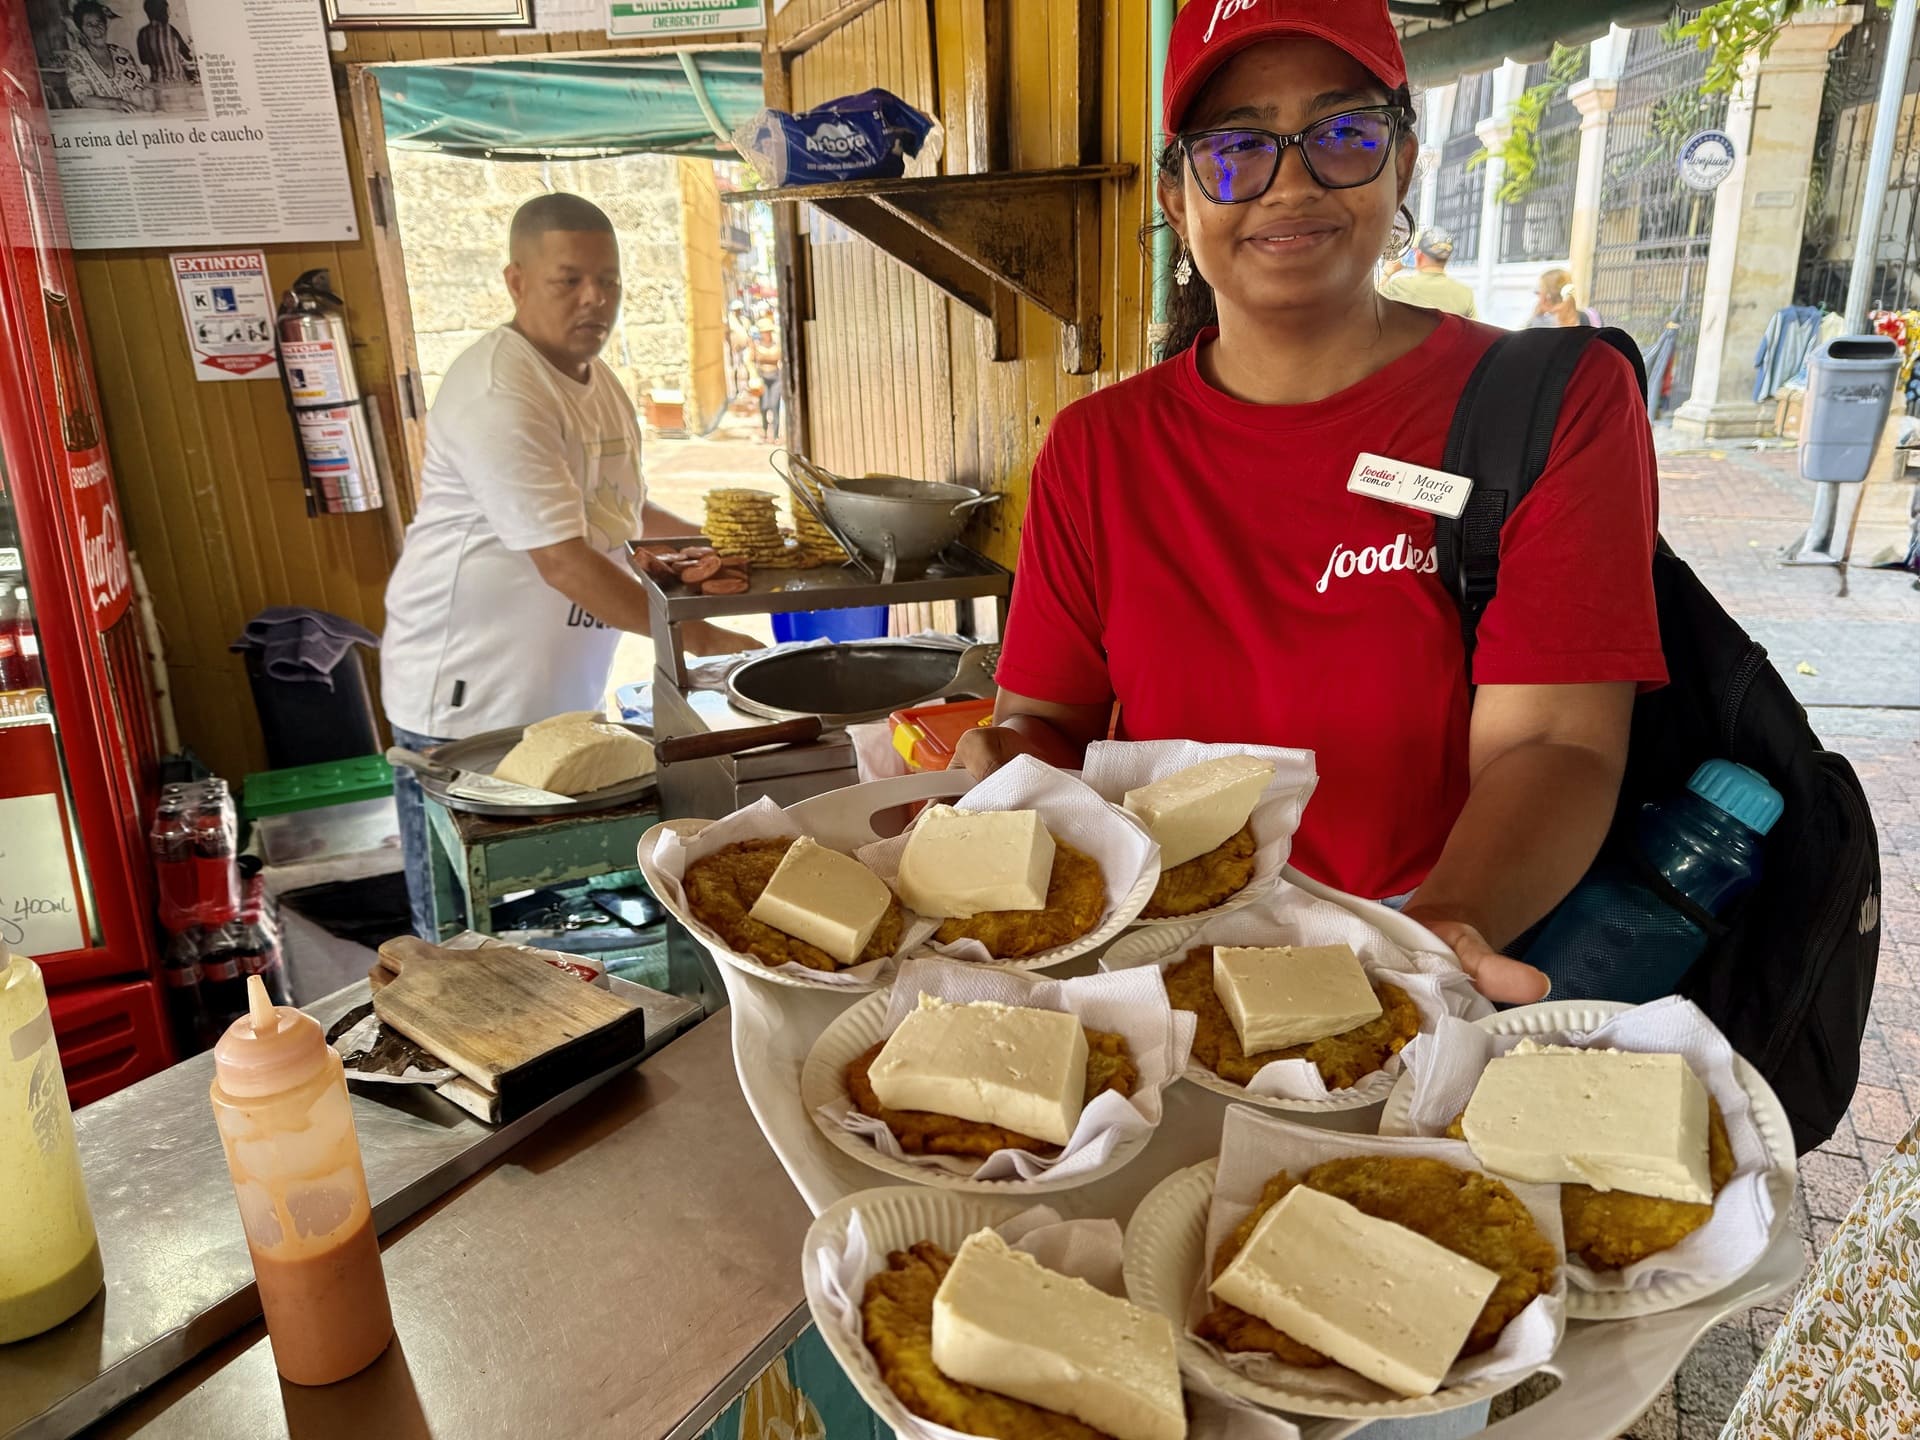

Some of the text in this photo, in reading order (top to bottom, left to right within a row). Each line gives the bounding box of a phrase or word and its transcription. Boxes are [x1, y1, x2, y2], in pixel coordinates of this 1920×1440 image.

[652, 13, 720, 29] EMERGENCY EXIT
[51, 133, 70, 149] La
[75, 131, 112, 148] reina
[116, 129, 138, 146] del
[142, 128, 185, 149] palito
[189, 127, 206, 143] de
[210, 125, 264, 142] caucho
[806, 133, 867, 152] Arbora
[175, 255, 261, 271] EXTINTOR
[194, 295, 208, 307] K
[1359, 465, 1396, 482] foodies
[1360, 476, 1391, 488] .com.co
[1413, 474, 1454, 494] María
[1413, 488, 1444, 504] José
[1316, 533, 1439, 593] foodies
